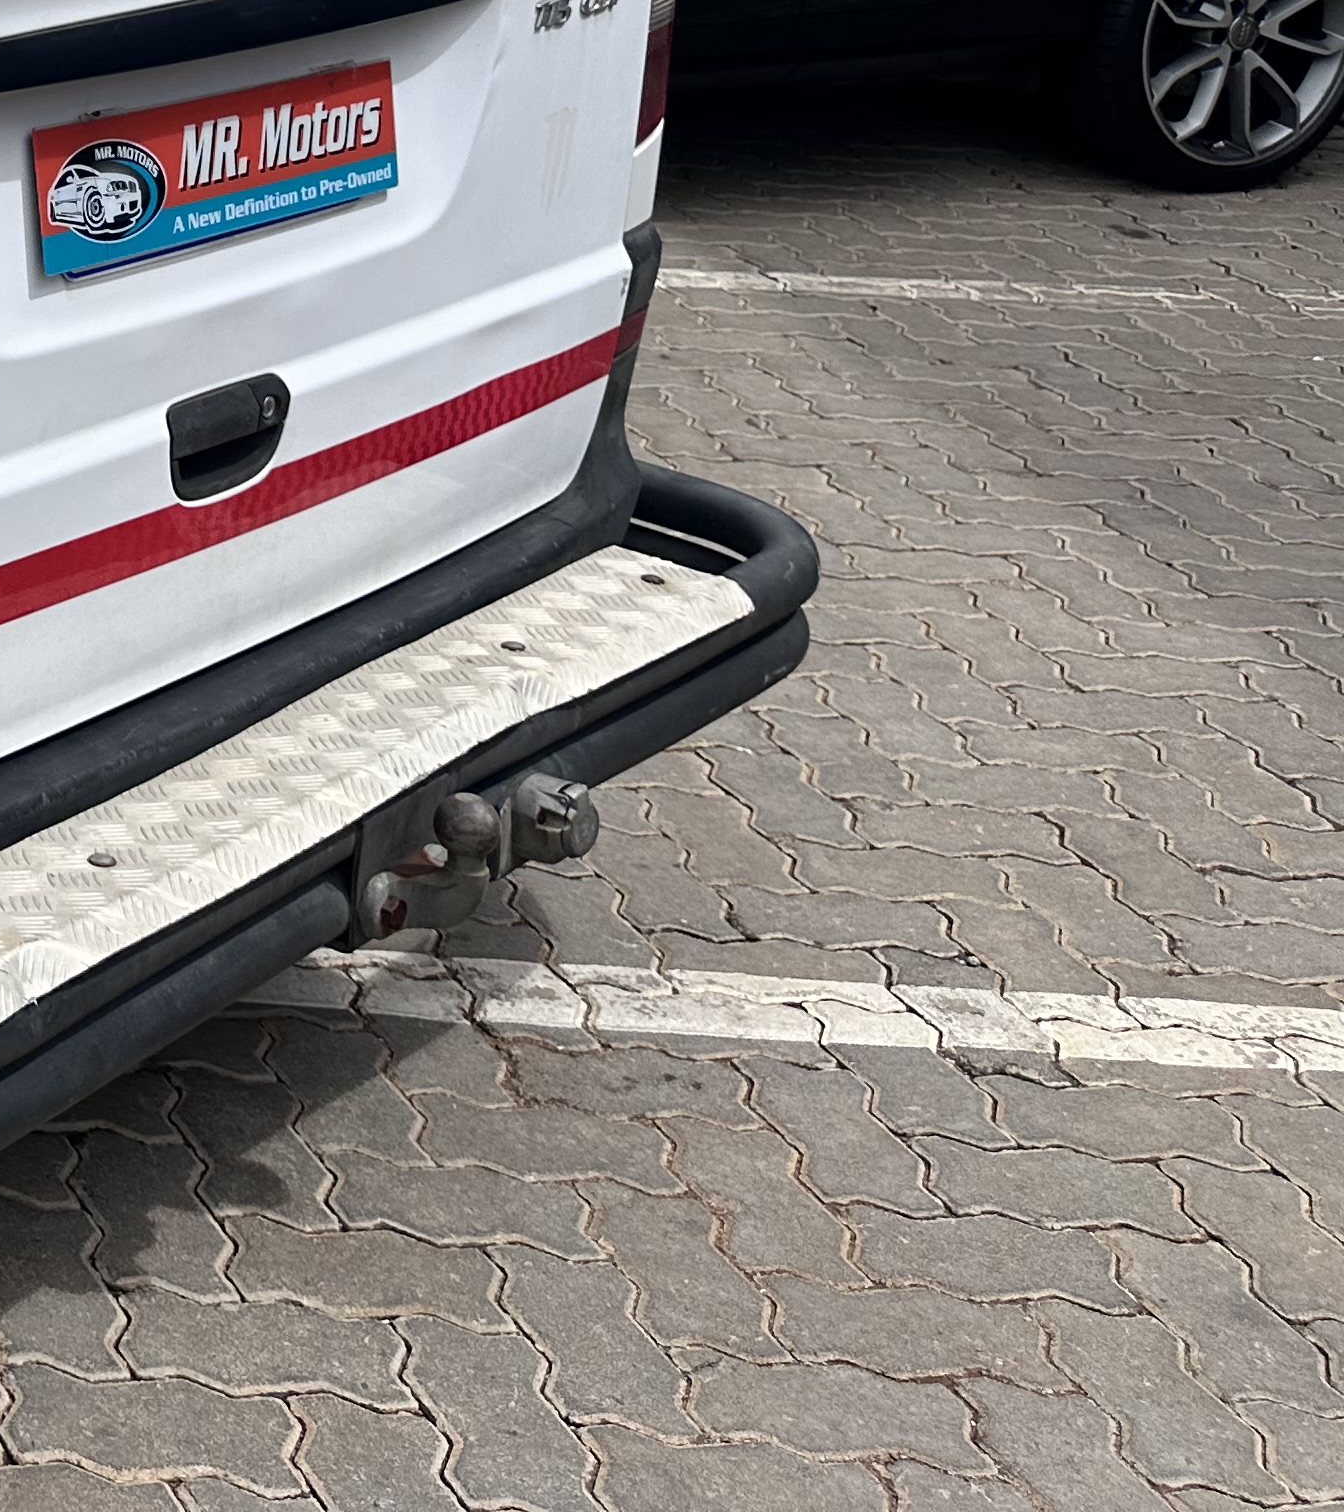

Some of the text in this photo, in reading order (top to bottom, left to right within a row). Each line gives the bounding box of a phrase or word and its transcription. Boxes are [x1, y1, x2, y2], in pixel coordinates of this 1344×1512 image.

[94, 145, 160, 178] MR. MOTORS
[178, 97, 382, 189] MR. Motors
[172, 163, 392, 235] A New Definition to Pre-Owned
